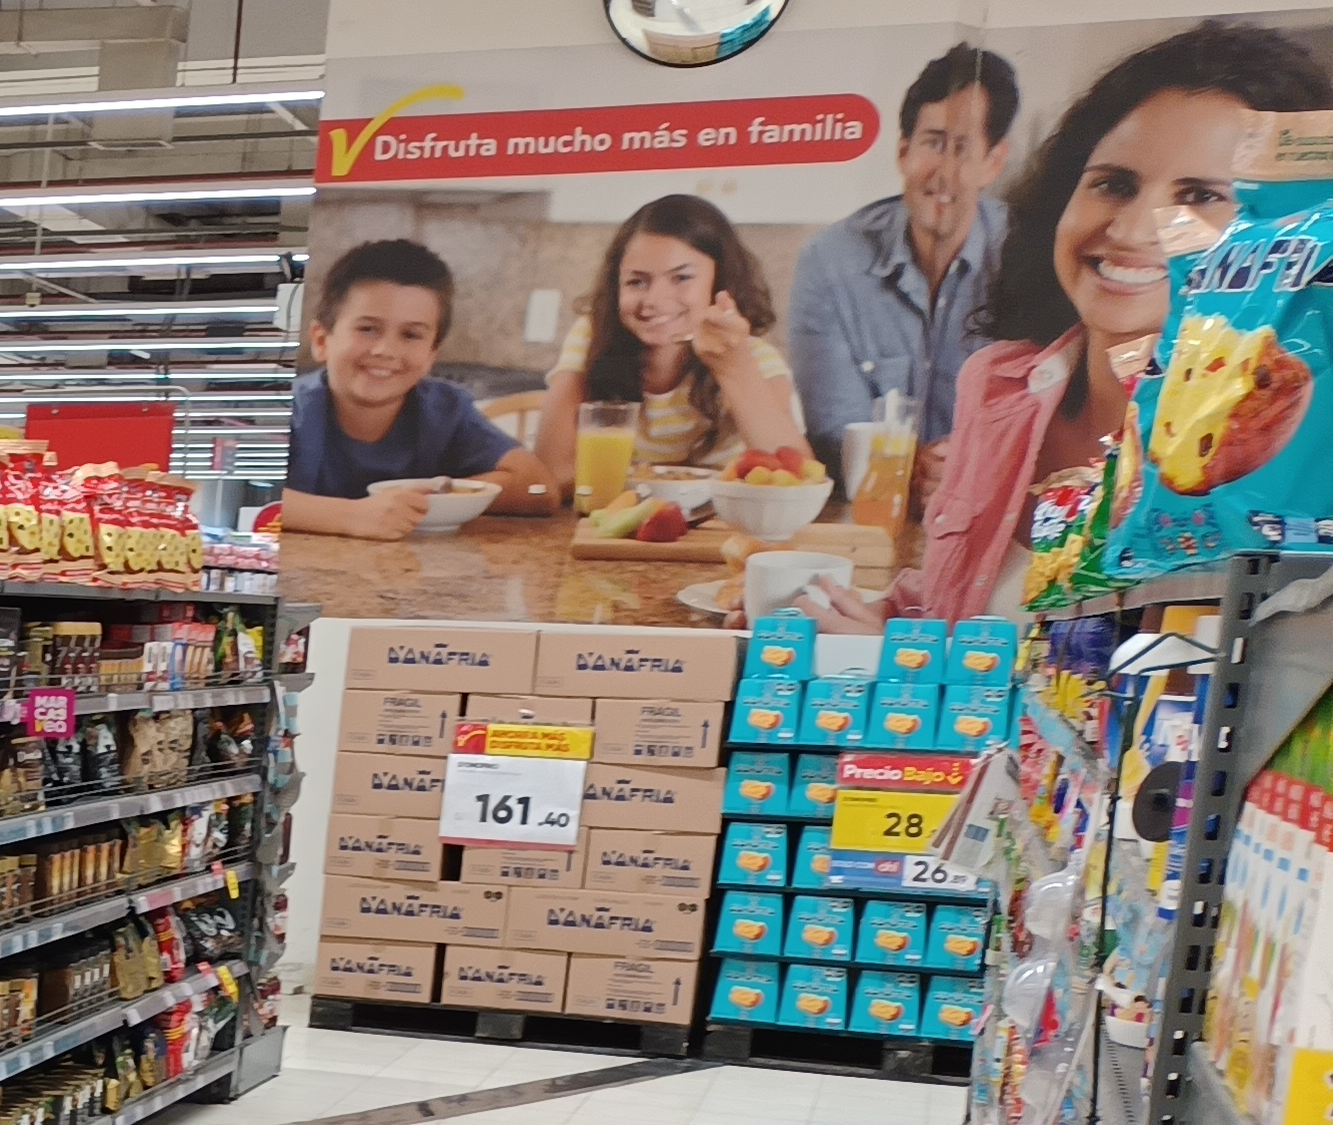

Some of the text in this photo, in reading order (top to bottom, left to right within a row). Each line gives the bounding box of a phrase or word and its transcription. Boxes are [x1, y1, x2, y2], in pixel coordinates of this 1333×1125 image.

[374, 113, 864, 162] Disfruta mucho más en familia
[842, 764, 946, 785] Precio Bajo
[475, 793, 532, 826] 161
[883, 812, 924, 838] 28
[912, 860, 948, 884] 26
